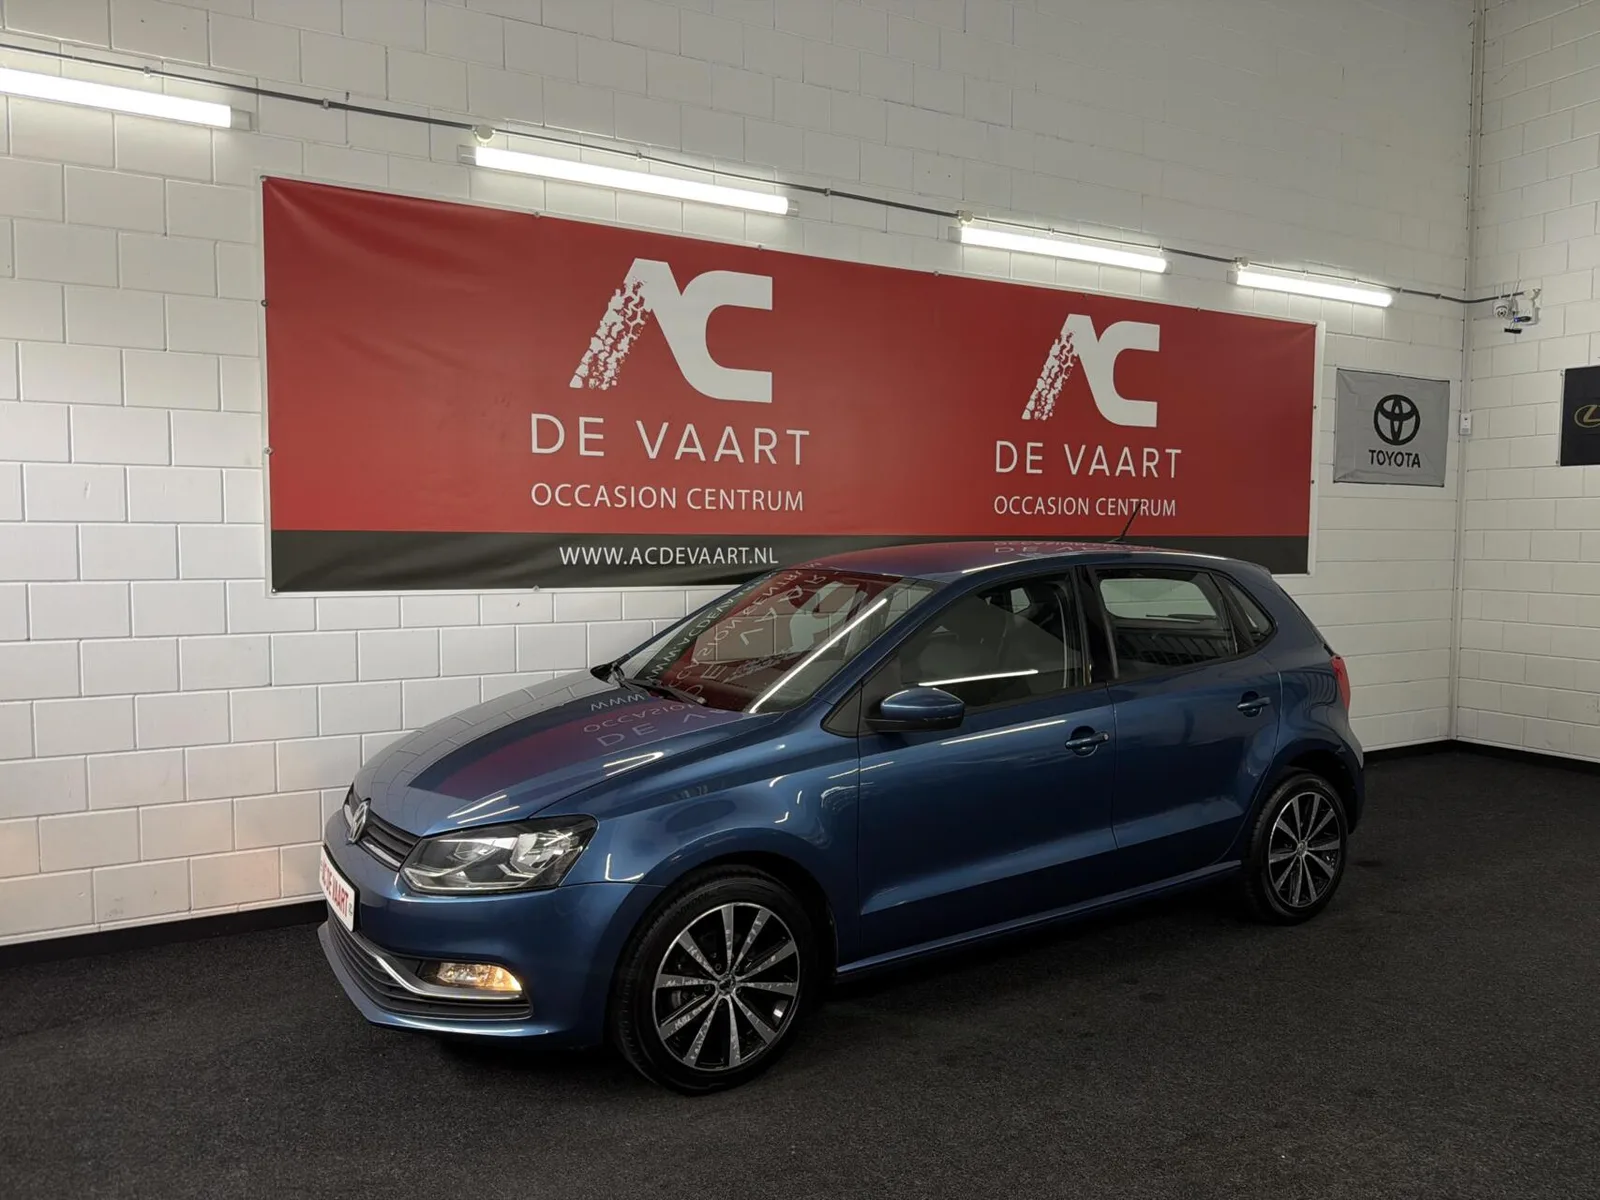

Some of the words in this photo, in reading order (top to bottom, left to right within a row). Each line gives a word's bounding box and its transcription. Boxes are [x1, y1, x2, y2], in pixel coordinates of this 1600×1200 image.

[569, 258, 772, 403] AC
[1021, 313, 1160, 428] AC
[531, 413, 604, 457] DE
[636, 420, 810, 465] VAART
[995, 440, 1044, 474] DE
[1063, 443, 1182, 478] VAART
[1368, 449, 1421, 468] TOYOTA
[531, 482, 677, 510] OCCASION
[686, 488, 803, 511] CENTRUM
[994, 495, 1089, 516] OCCASION
[1095, 498, 1176, 517] CENTRUM
[559, 546, 779, 566] WWW.ACDEVAART.NL
